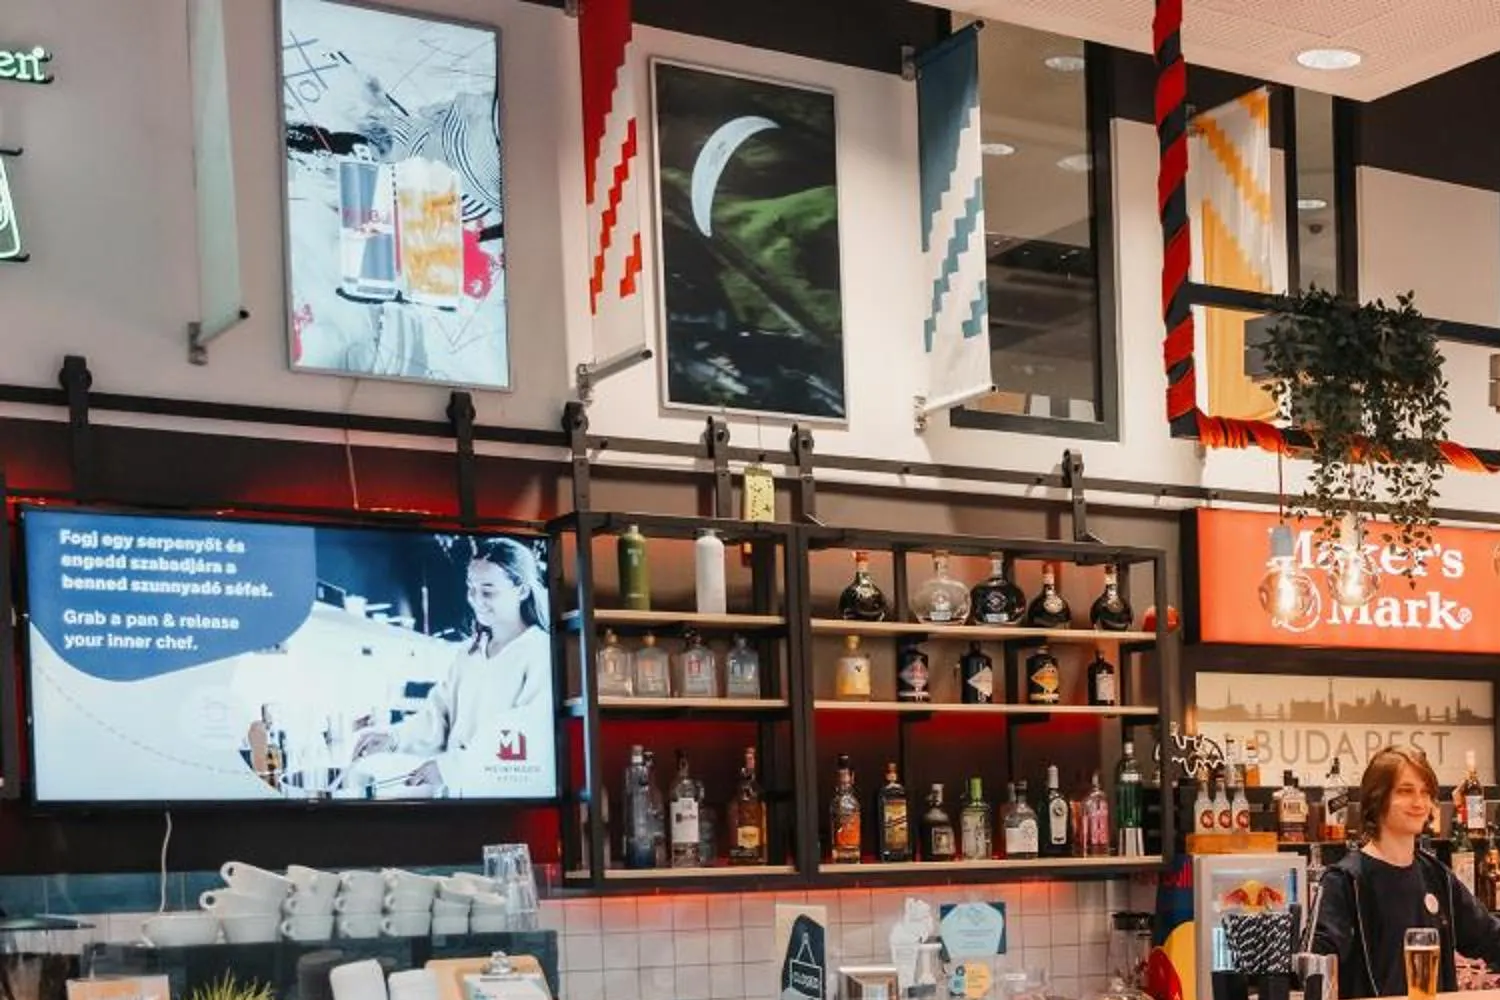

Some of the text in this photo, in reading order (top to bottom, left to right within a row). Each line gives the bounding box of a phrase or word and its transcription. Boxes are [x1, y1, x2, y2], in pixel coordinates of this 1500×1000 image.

[59, 528, 99, 549] Fogj
[101, 532, 134, 550] egy
[225, 538, 246, 553] és
[225, 562, 238, 575] a
[61, 573, 128, 591] benned
[63, 608, 241, 630] Grab a pan & release
[63, 633, 199, 651] your inner chef.
[1253, 729, 1452, 767] BUDAPEST
